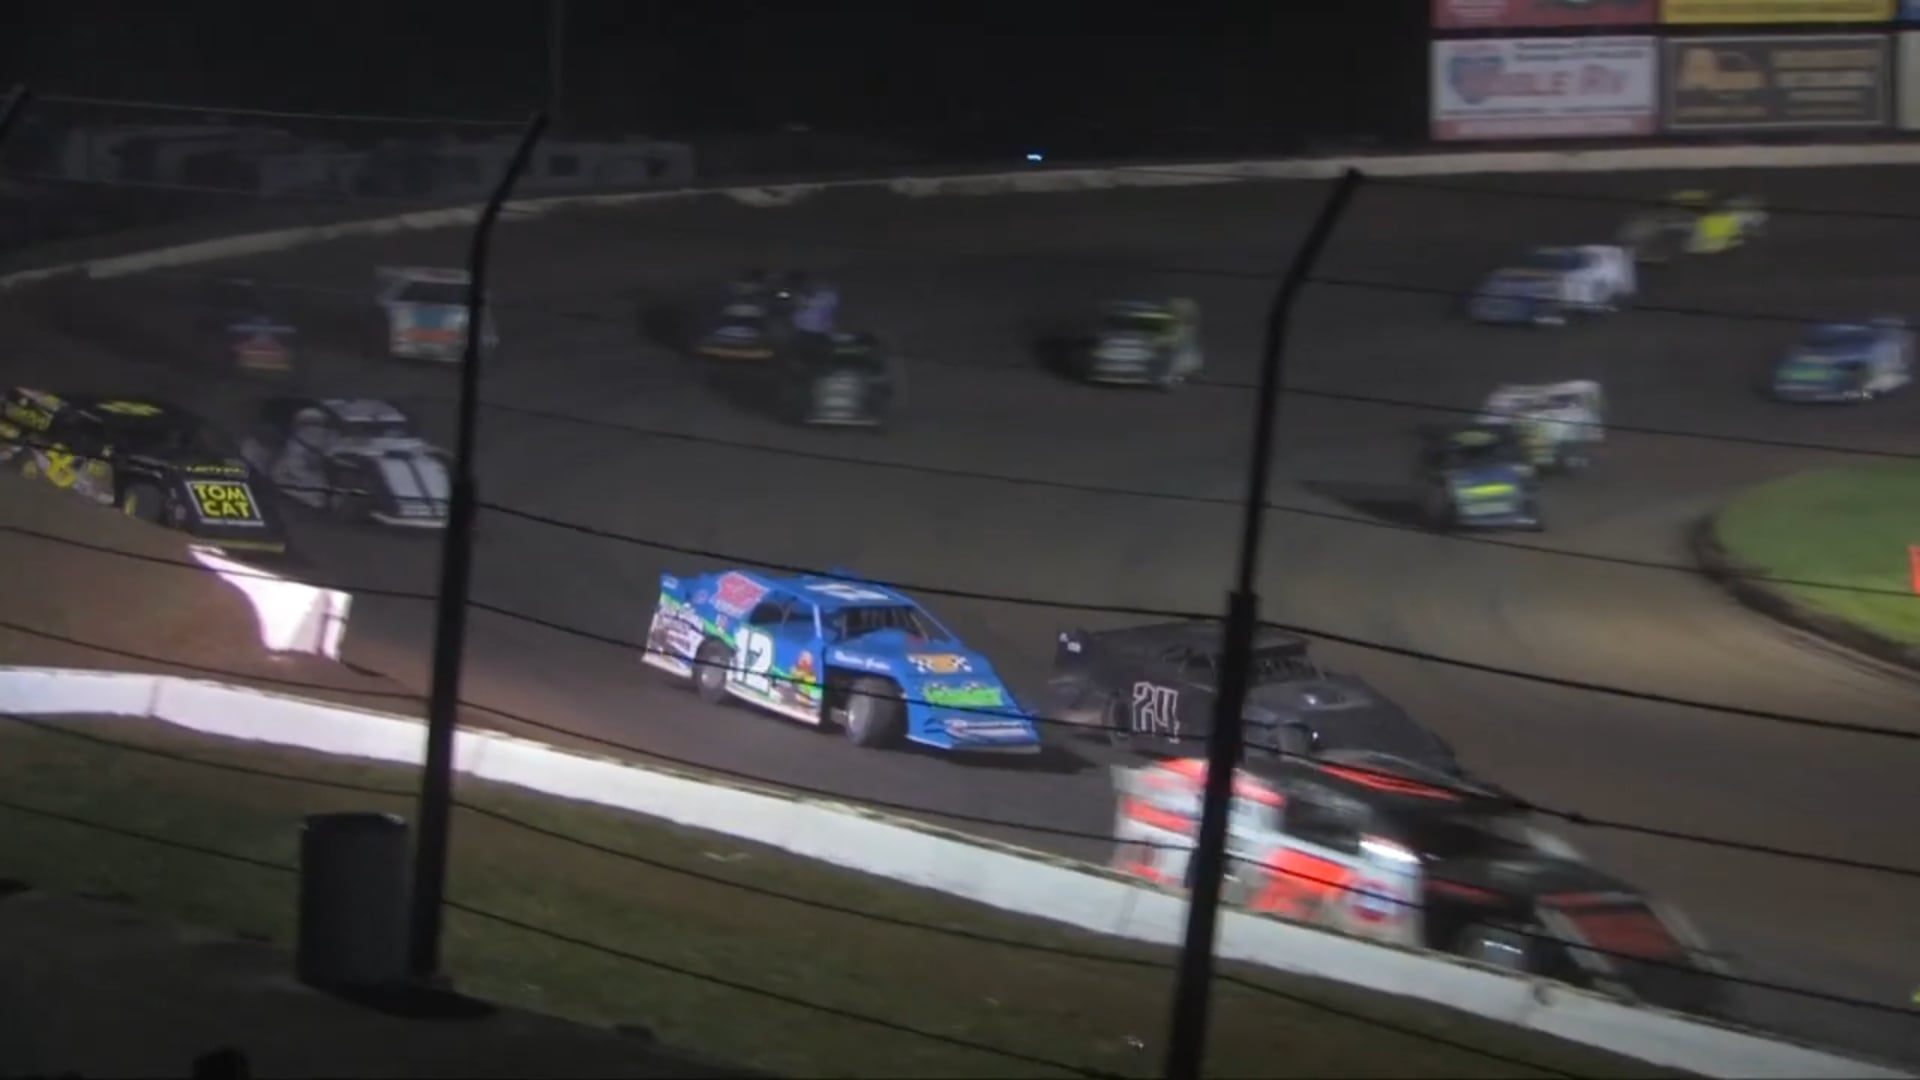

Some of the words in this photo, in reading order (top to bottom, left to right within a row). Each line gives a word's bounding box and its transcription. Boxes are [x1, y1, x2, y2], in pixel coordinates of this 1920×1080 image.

[193, 483, 247, 501] TOM
[203, 500, 250, 518] CAT
[726, 627, 774, 694] 12
[1132, 681, 1181, 744] 24
